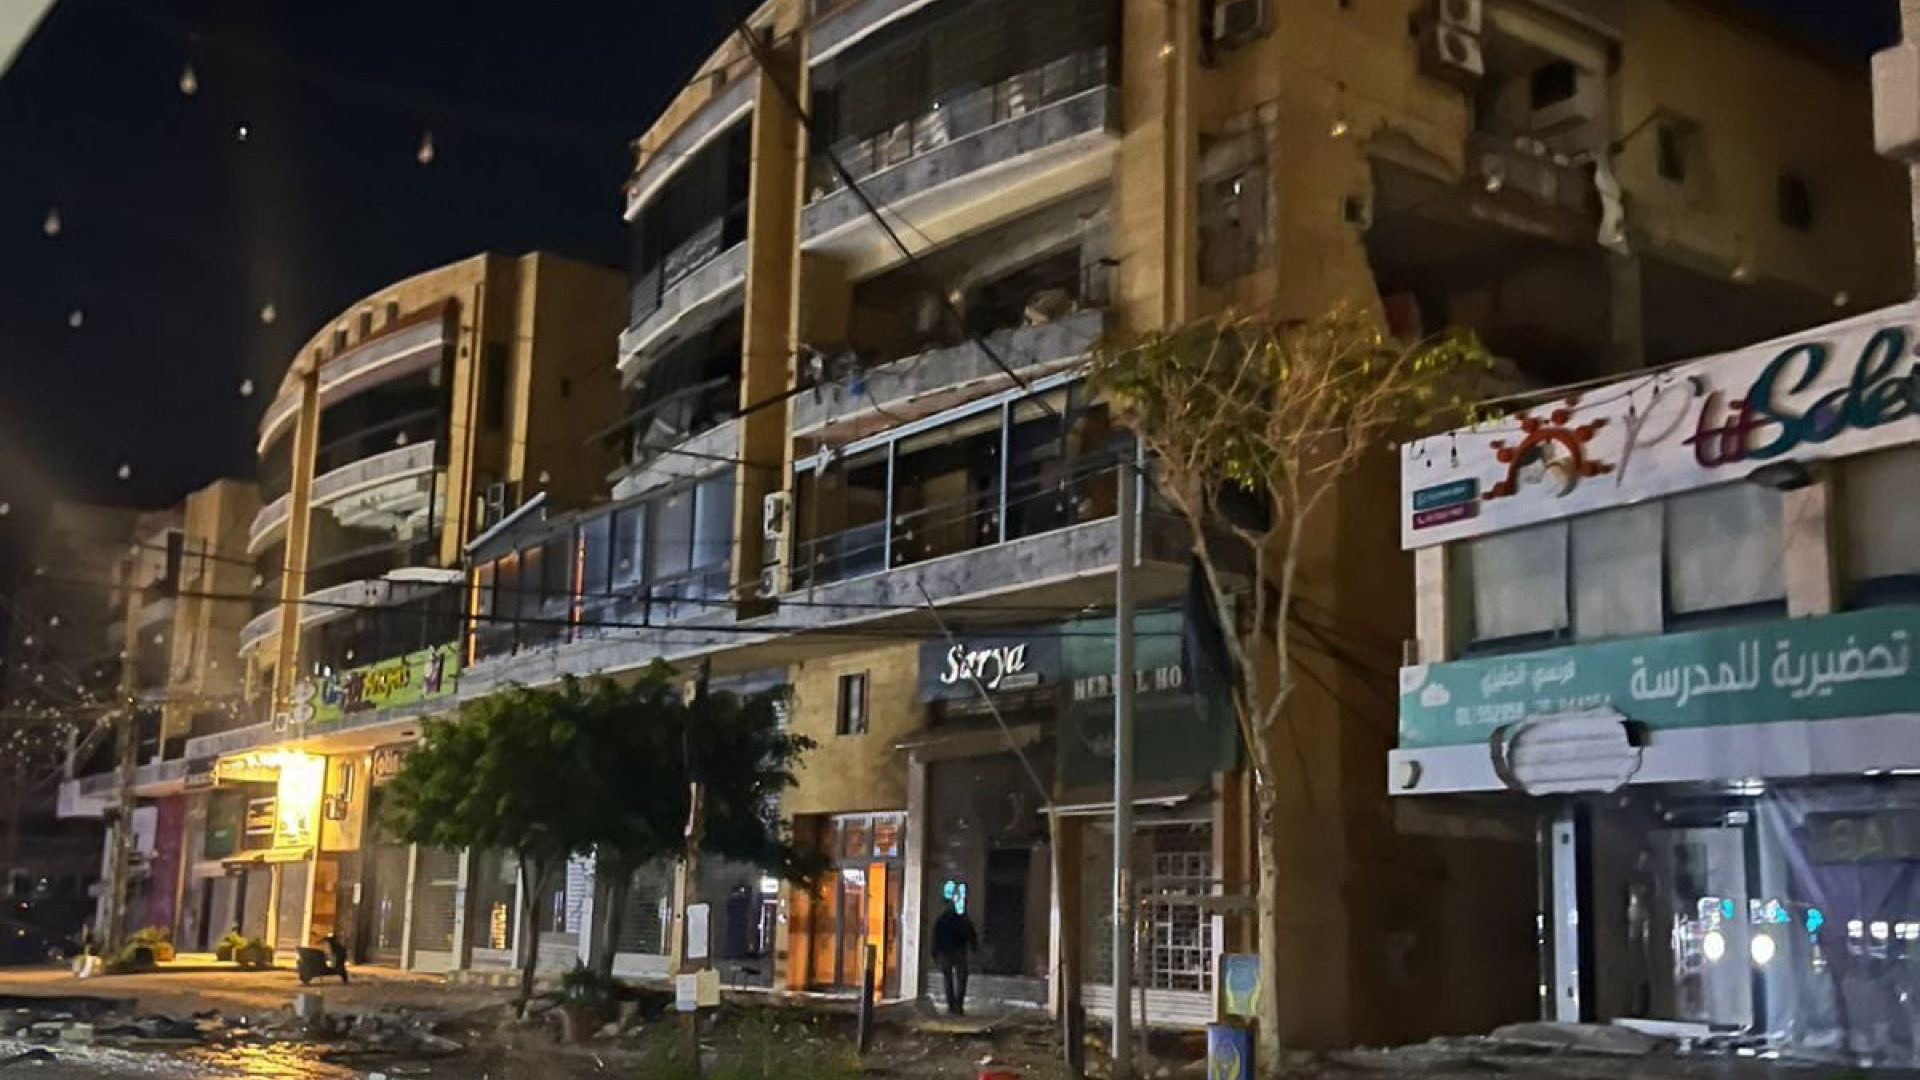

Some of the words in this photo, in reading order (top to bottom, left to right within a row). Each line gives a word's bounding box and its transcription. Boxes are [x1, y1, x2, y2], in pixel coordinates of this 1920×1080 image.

[1074, 669, 1150, 701] HERL
[1154, 665, 1183, 691] HO
[1631, 639, 1760, 708] للمدرسة
[1772, 630, 1907, 699] تحضيرية
